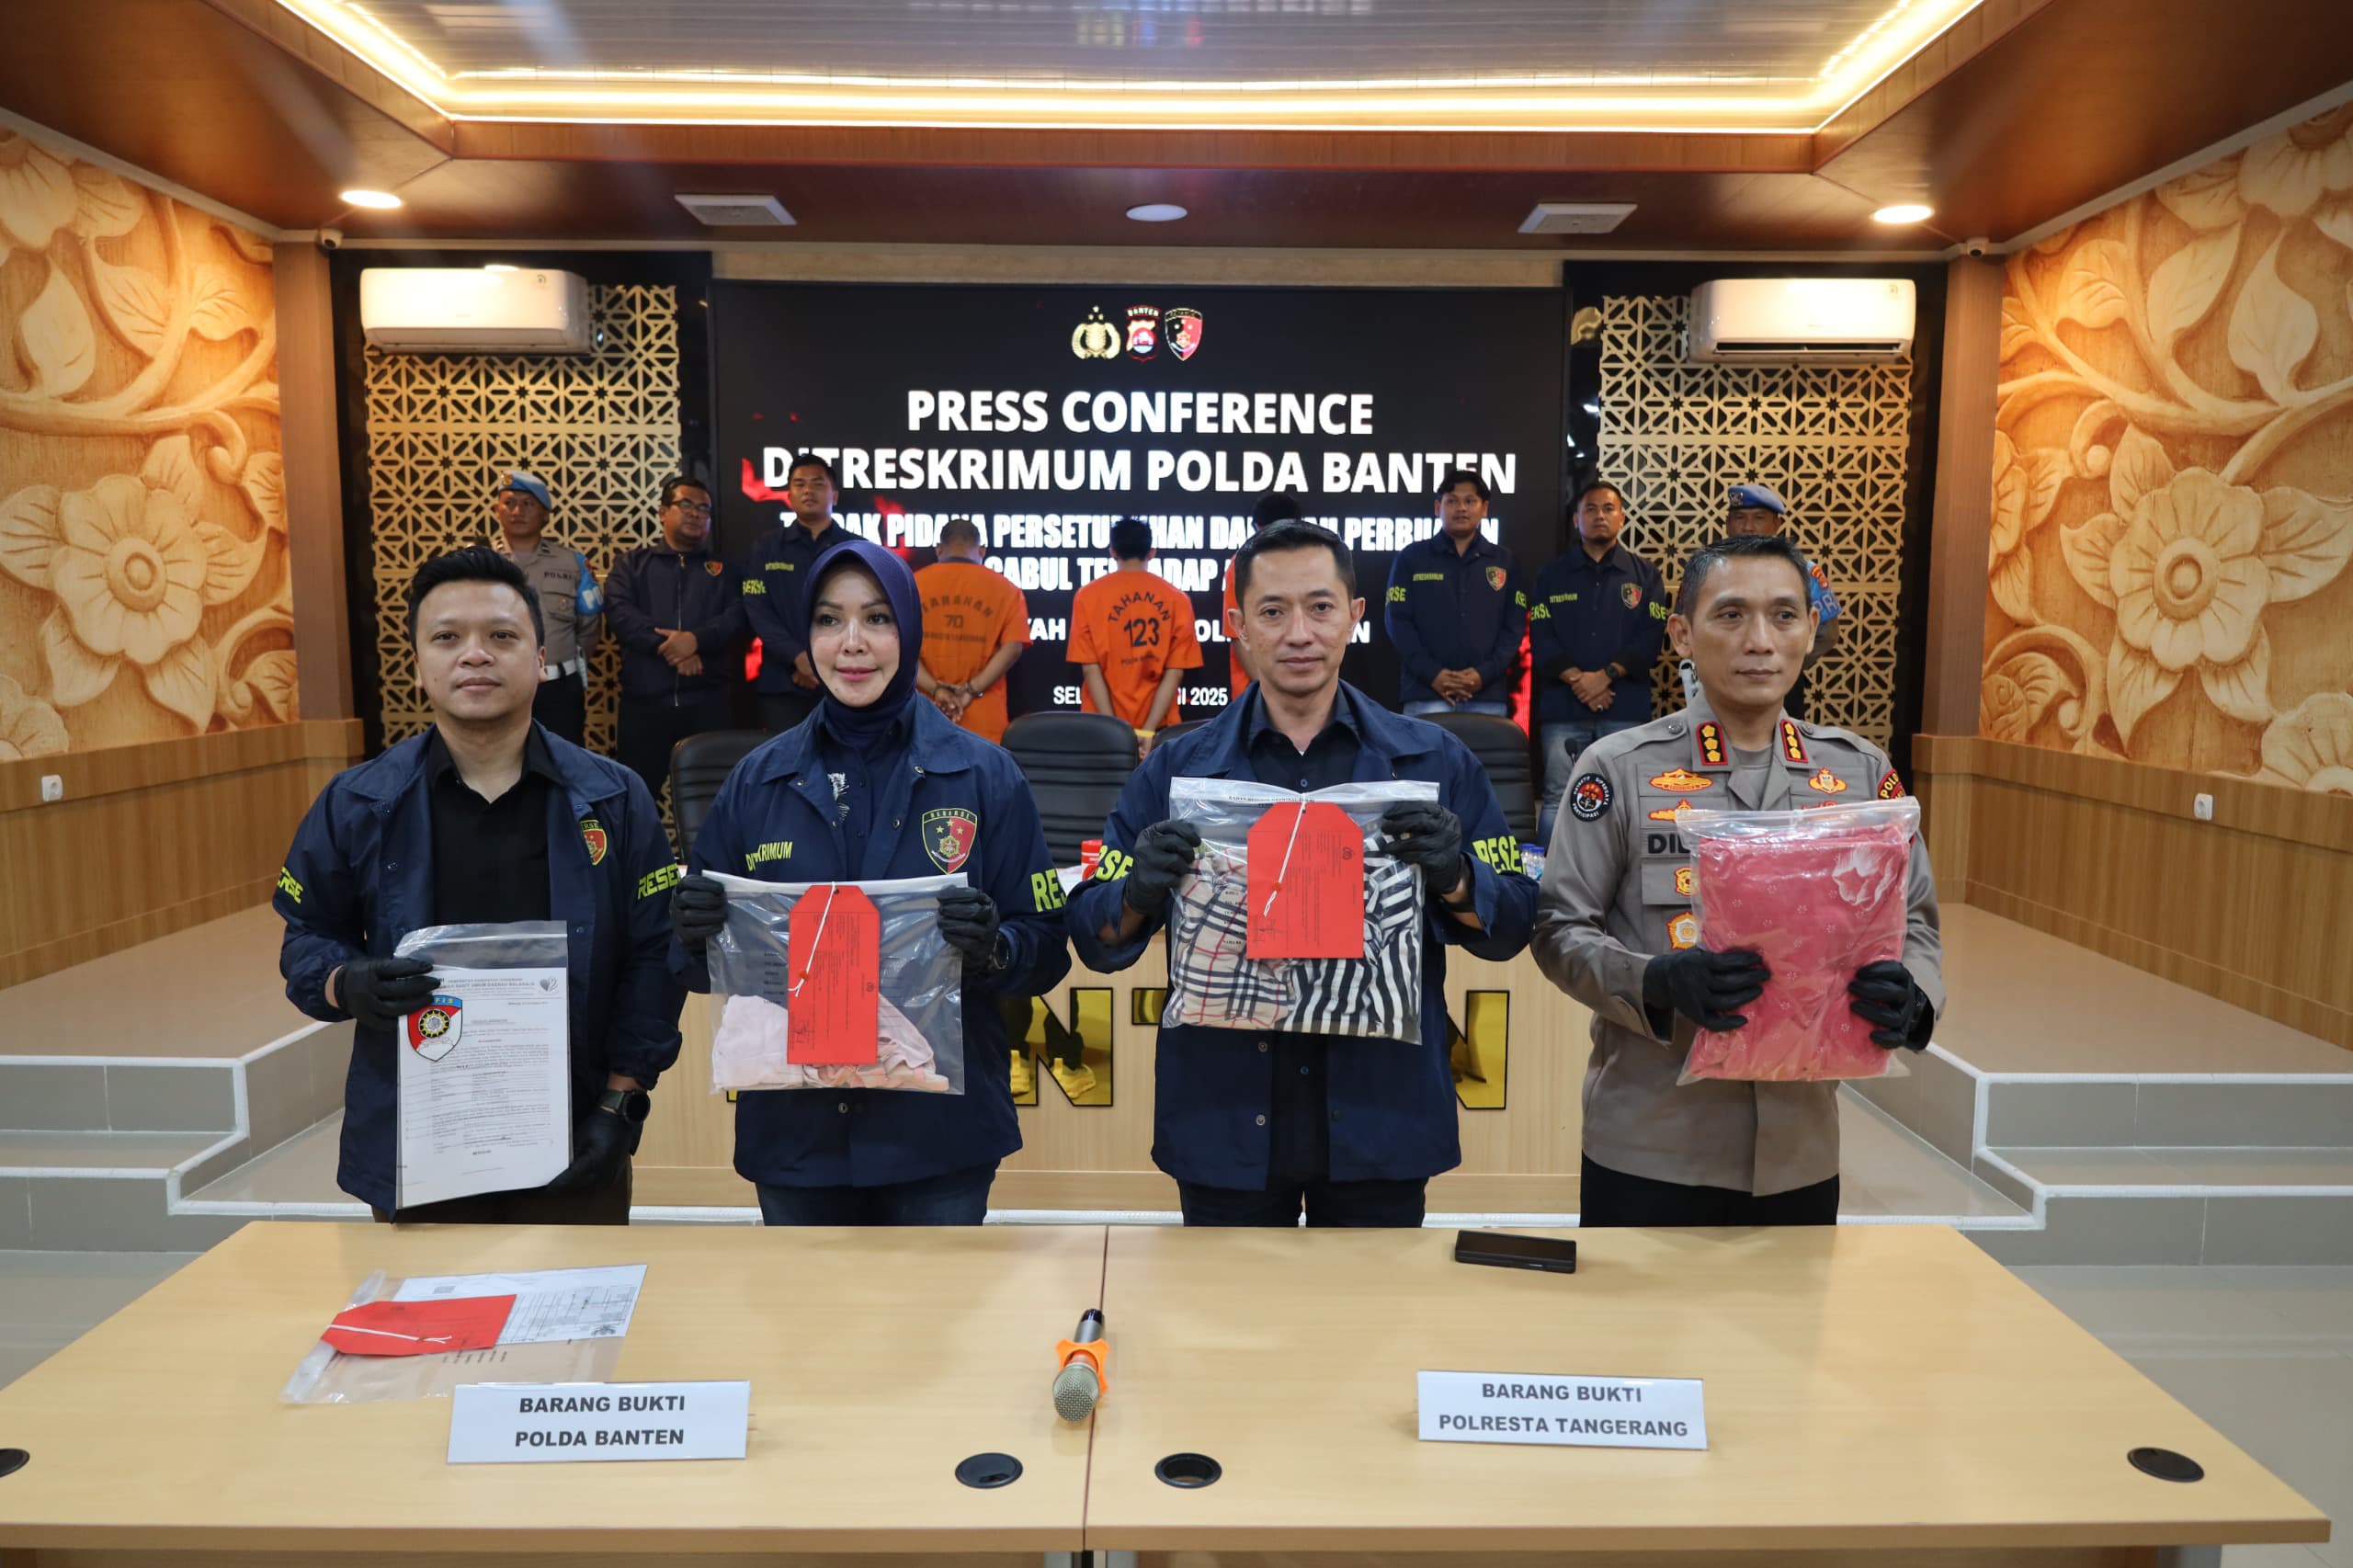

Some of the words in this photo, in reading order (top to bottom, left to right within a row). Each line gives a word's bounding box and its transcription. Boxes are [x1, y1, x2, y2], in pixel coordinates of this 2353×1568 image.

[908, 390, 1049, 433] PRESS
[1062, 390, 1374, 435] CONFERENCE
[763, 447, 1131, 491] DTRESKRIMUM
[1147, 450, 1309, 492] POLDA
[887, 514, 988, 548] PIDAA
[994, 515, 1204, 550] PERSETUHAN
[1108, 591, 1172, 622] TAHANAN
[1123, 618, 1160, 647] 123
[1190, 687, 1229, 706] 2025
[1472, 835, 1527, 875] RESE
[519, 1396, 611, 1414] BARANG
[618, 1395, 686, 1412] BUKTI
[1482, 1382, 1570, 1401] BARANG
[1577, 1386, 1643, 1403] BUKTI
[515, 1430, 588, 1448] POLDA
[595, 1428, 685, 1447] BANTEN
[1438, 1414, 1550, 1433] POLRESTA
[1555, 1417, 1688, 1437] TANGERANG
